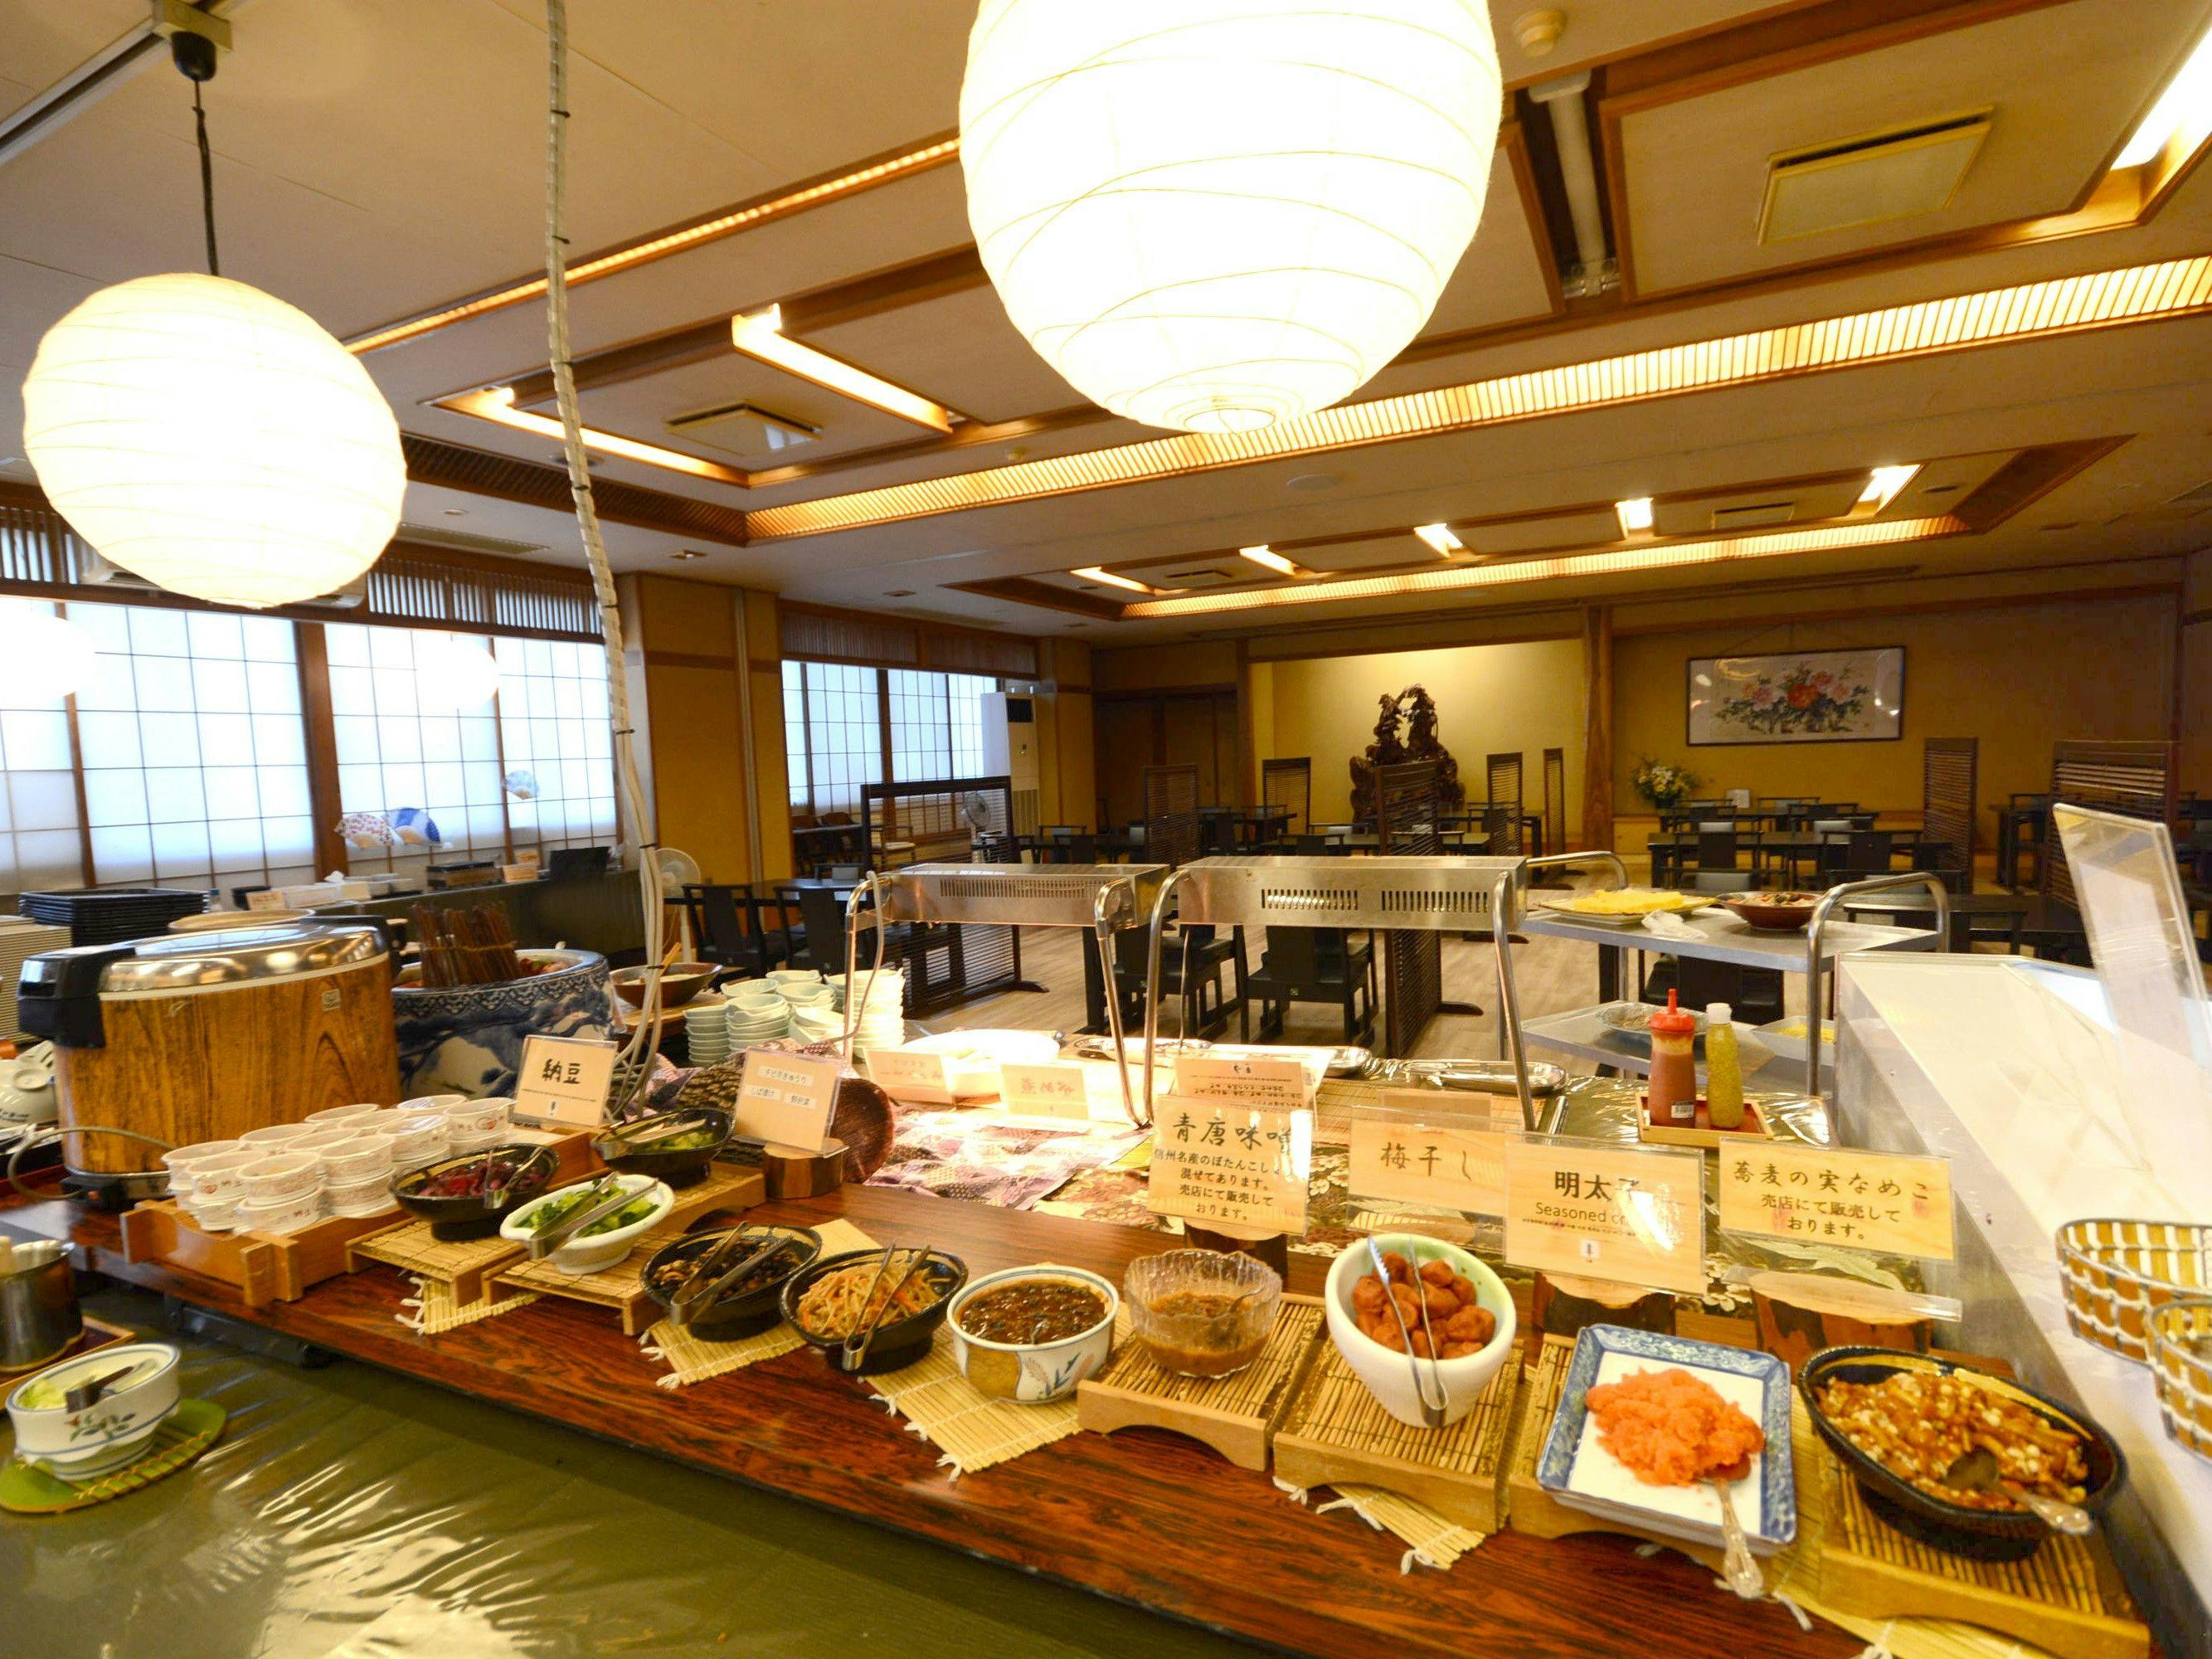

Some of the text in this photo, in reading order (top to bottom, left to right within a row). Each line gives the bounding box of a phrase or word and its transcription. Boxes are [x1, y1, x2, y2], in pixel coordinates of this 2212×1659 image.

[541, 1058, 581, 1085] 納豆
[1379, 1141, 1473, 1182] 梅干し
[1180, 1167, 1269, 1191] 混ぜてあります。
[1733, 1160, 1929, 1200] 蕎麦の実なめこ
[1179, 1183, 1274, 1207] 売店にて販売して
[1761, 1193, 1901, 1223] 売店にて販売して
[1195, 1203, 1248, 1221] おります。
[1535, 1201, 1607, 1223] Seasoned
[1787, 1215, 1864, 1241] おります。
